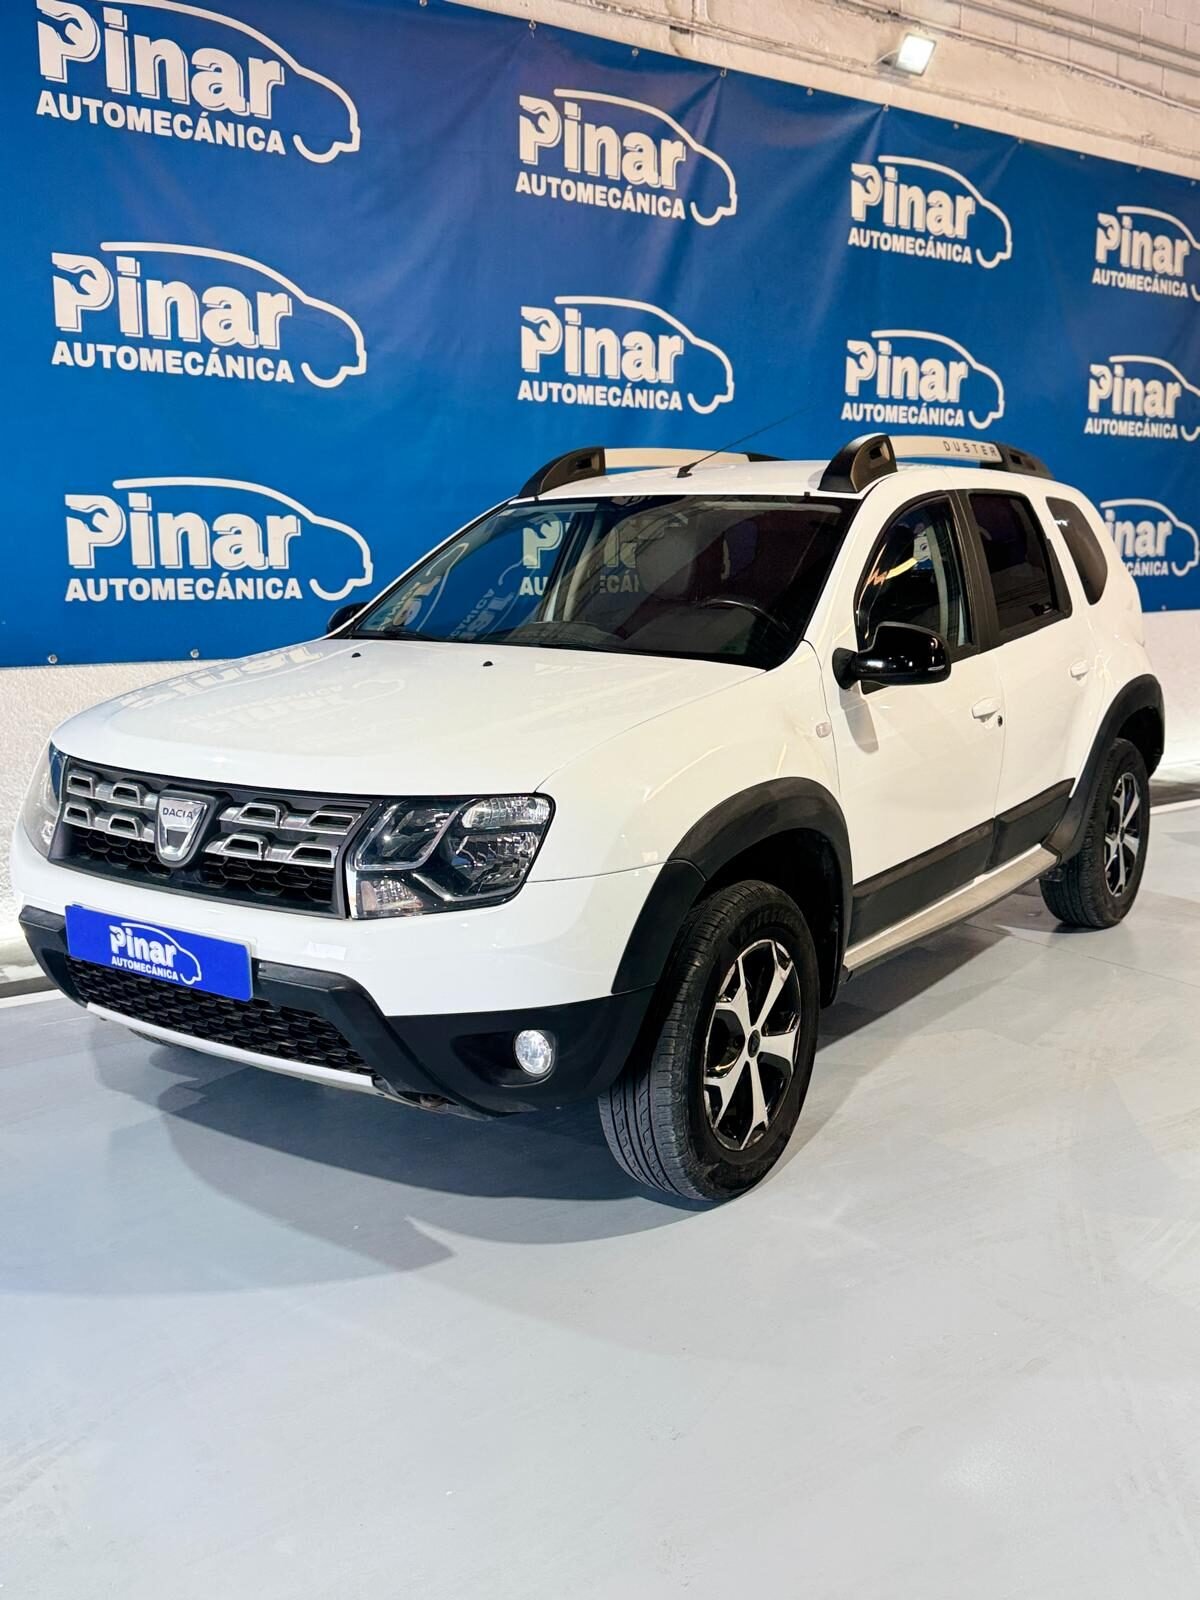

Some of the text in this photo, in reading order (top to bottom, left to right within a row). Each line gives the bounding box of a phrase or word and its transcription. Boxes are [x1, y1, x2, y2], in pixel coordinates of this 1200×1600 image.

[37, 0, 285, 119] Pinar
[37, 91, 286, 155] AUTOMECÁNICA
[518, 95, 687, 190] Pinar
[514, 172, 686, 220] AUTOMECÁNICA
[850, 163, 976, 240] Pinar
[847, 228, 973, 264] AUTOMECÁNICA
[1095, 212, 1190, 277] Pinar
[52, 252, 293, 350] Pinar
[1091, 267, 1189, 298] AUTOMECÁNICA
[52, 341, 295, 384] AUTOMECÁNICA
[520, 306, 685, 384] Pinar
[844, 339, 969, 403] Pinar
[1088, 363, 1182, 418] Pinar
[517, 380, 683, 413] AUTOMECÁNICA
[840, 400, 965, 427] AUTOMECÁNICA
[943, 440, 998, 456] DUSTER
[1084, 418, 1178, 439] AUTOMECÁNICA
[65, 493, 302, 570] Pinar
[1104, 509, 1172, 557] inar
[64, 572, 303, 601] AUTOMECÁNICA
[162, 807, 194, 820] DACIA
[109, 925, 177, 968] Pinar
[111, 955, 179, 981] AUTOMECÁNICA
